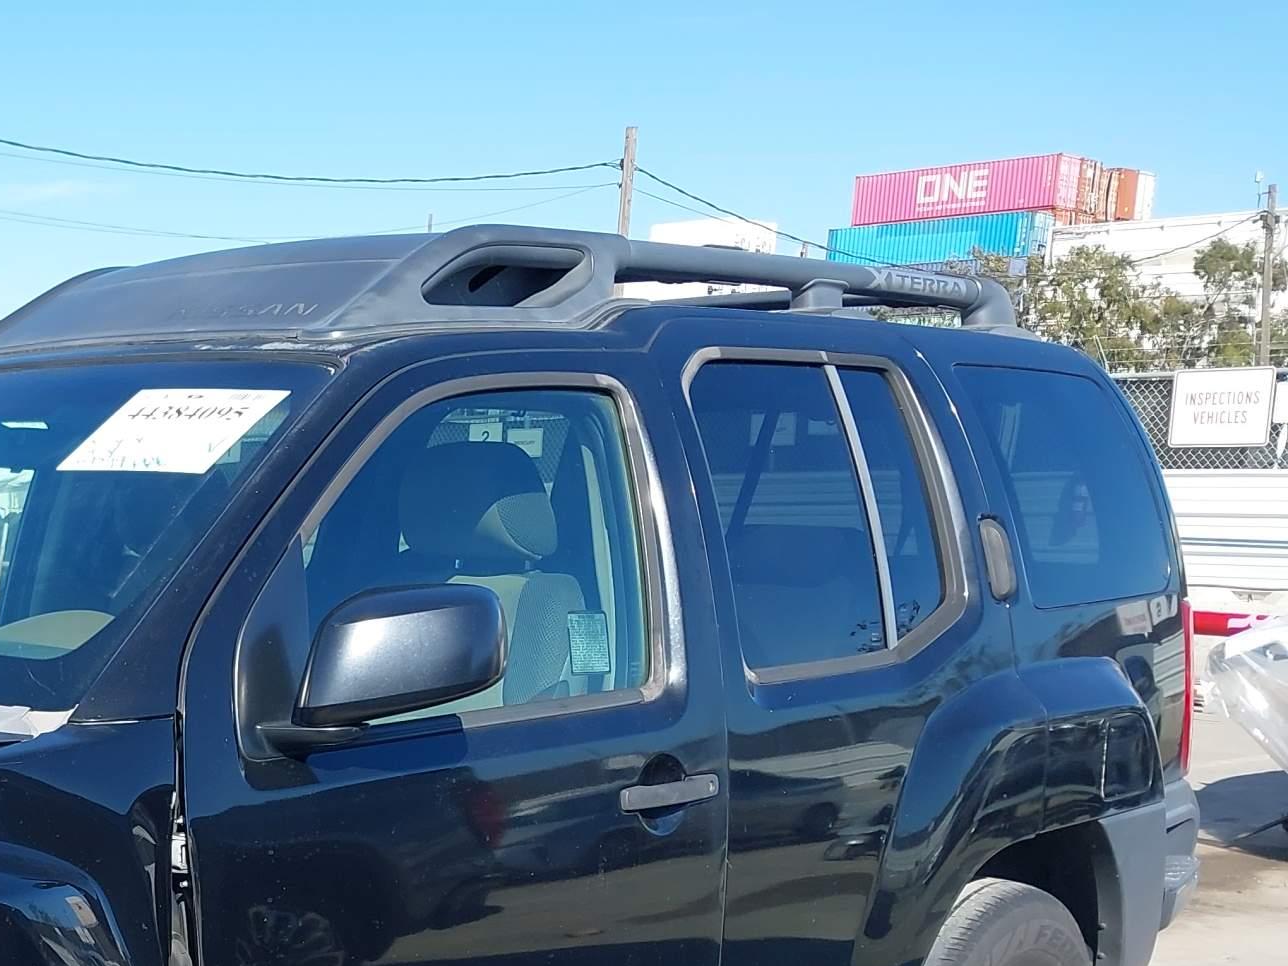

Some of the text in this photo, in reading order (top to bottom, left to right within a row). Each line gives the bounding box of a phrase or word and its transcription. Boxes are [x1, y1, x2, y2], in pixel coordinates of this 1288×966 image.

[916, 168, 989, 204] ONE
[168, 302, 319, 321] SSAN
[1185, 390, 1261, 406] INSPECTIONS
[1193, 410, 1248, 425] VEHICLES
